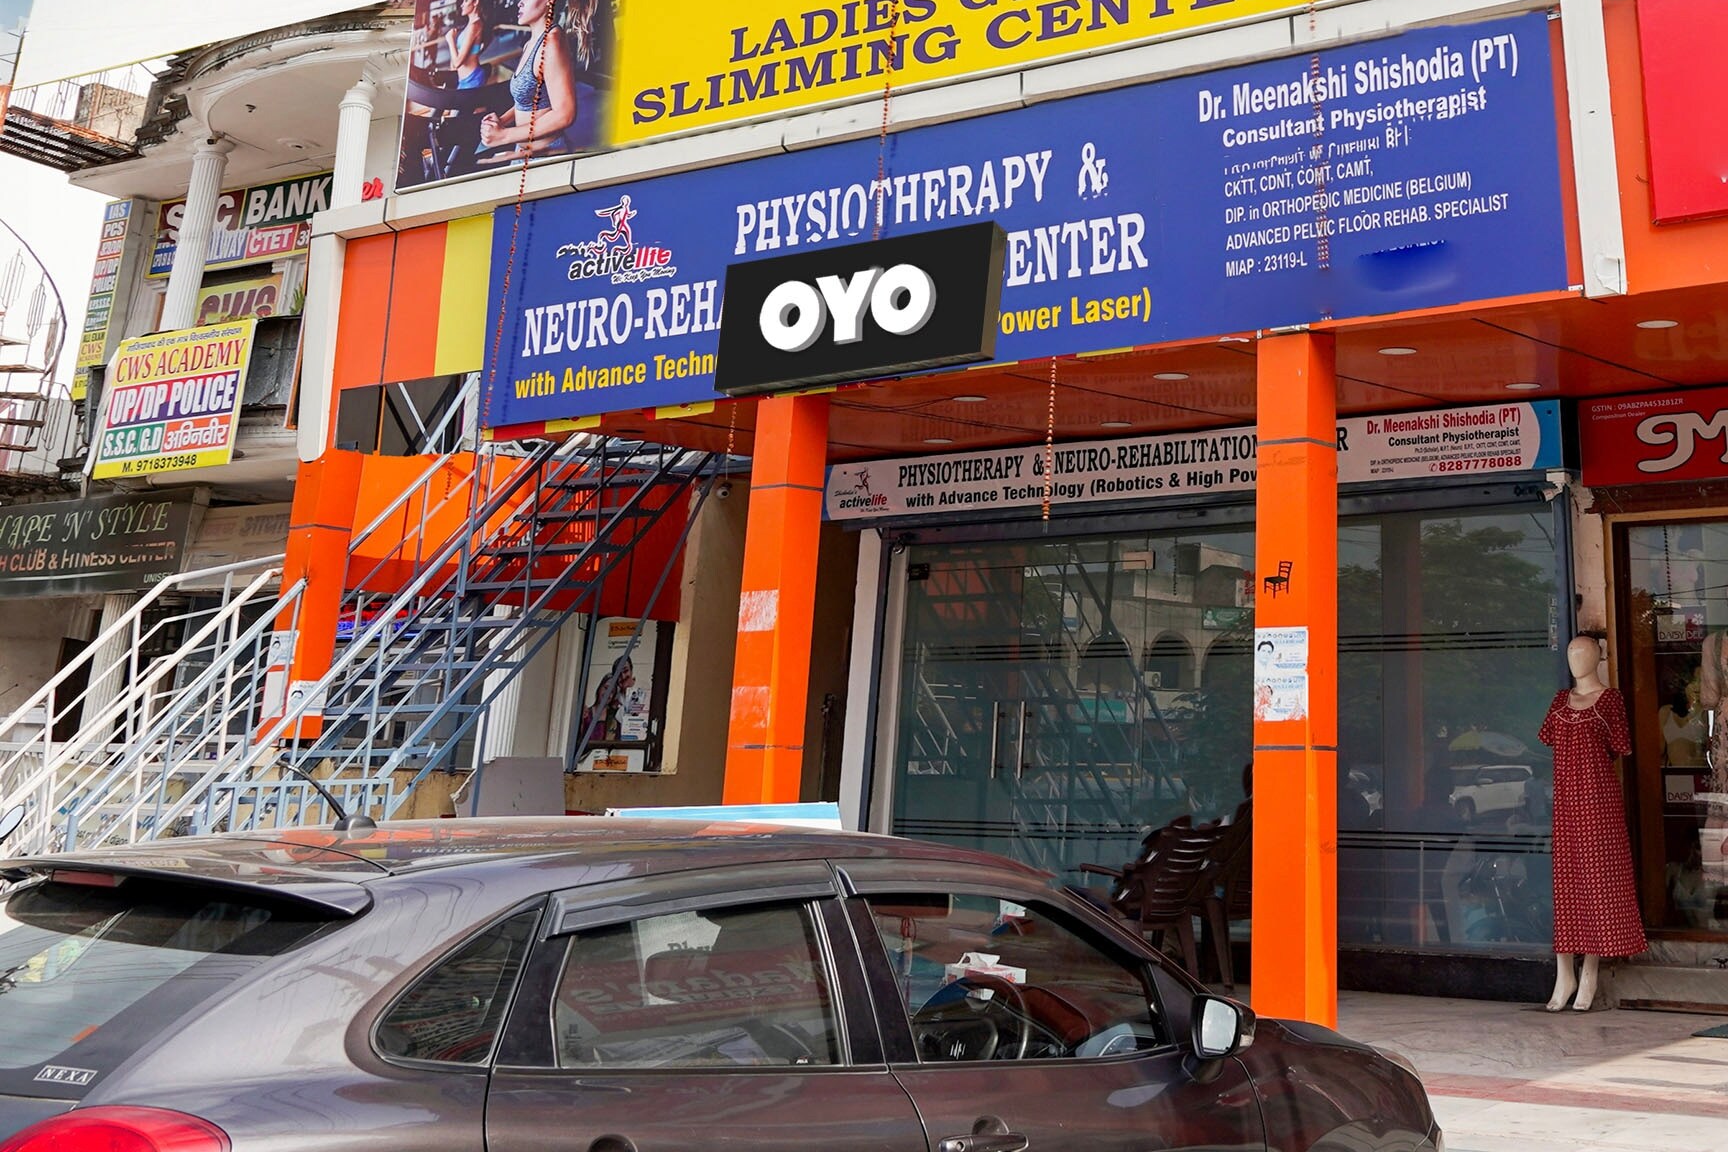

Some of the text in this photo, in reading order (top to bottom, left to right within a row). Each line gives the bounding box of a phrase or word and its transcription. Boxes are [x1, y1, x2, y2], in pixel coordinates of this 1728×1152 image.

[632, 25, 962, 126] SLIMMING
[1198, 33, 1519, 123] Dr. Meenakshi Shishodia (PT)
[1222, 85, 1487, 148] Consultant Physiotherapist
[109, 203, 126, 219] IAS
[244, 177, 332, 225] BANK
[734, 149, 1053, 255] PHYSIOTHERAPY
[1249, 171, 1471, 221] in MEDICINE (BELGIUM)
[103, 221, 124, 238] PCS
[248, 226, 294, 255] CTET
[1226, 193, 1509, 251] ADVANCED PELVIC FLOOR REHAB. SPECIALIST
[1226, 259, 1254, 278] MIAP
[759, 263, 937, 352] OYO
[116, 338, 246, 383] CWS ACADEMY
[515, 286, 1151, 399] with Advance Laser)
[110, 373, 237, 426] UP/DP POLICE
[1367, 407, 1521, 435] Dr. Meenakshi Shishodia (PT)
[1388, 433, 1440, 448] Consultant
[1442, 427, 1519, 444] Physiotherapist
[136, 454, 197, 472] 9718373948
[897, 455, 1024, 488] PHYSIOTHERAPY
[1439, 455, 1522, 472] 8287778088
[839, 493, 887, 509] activelife
[906, 469, 1223, 507] with Advance Technology (Robotics & High
[91, 500, 173, 541] STYLE
[41, 1068, 88, 1083] NEXA
